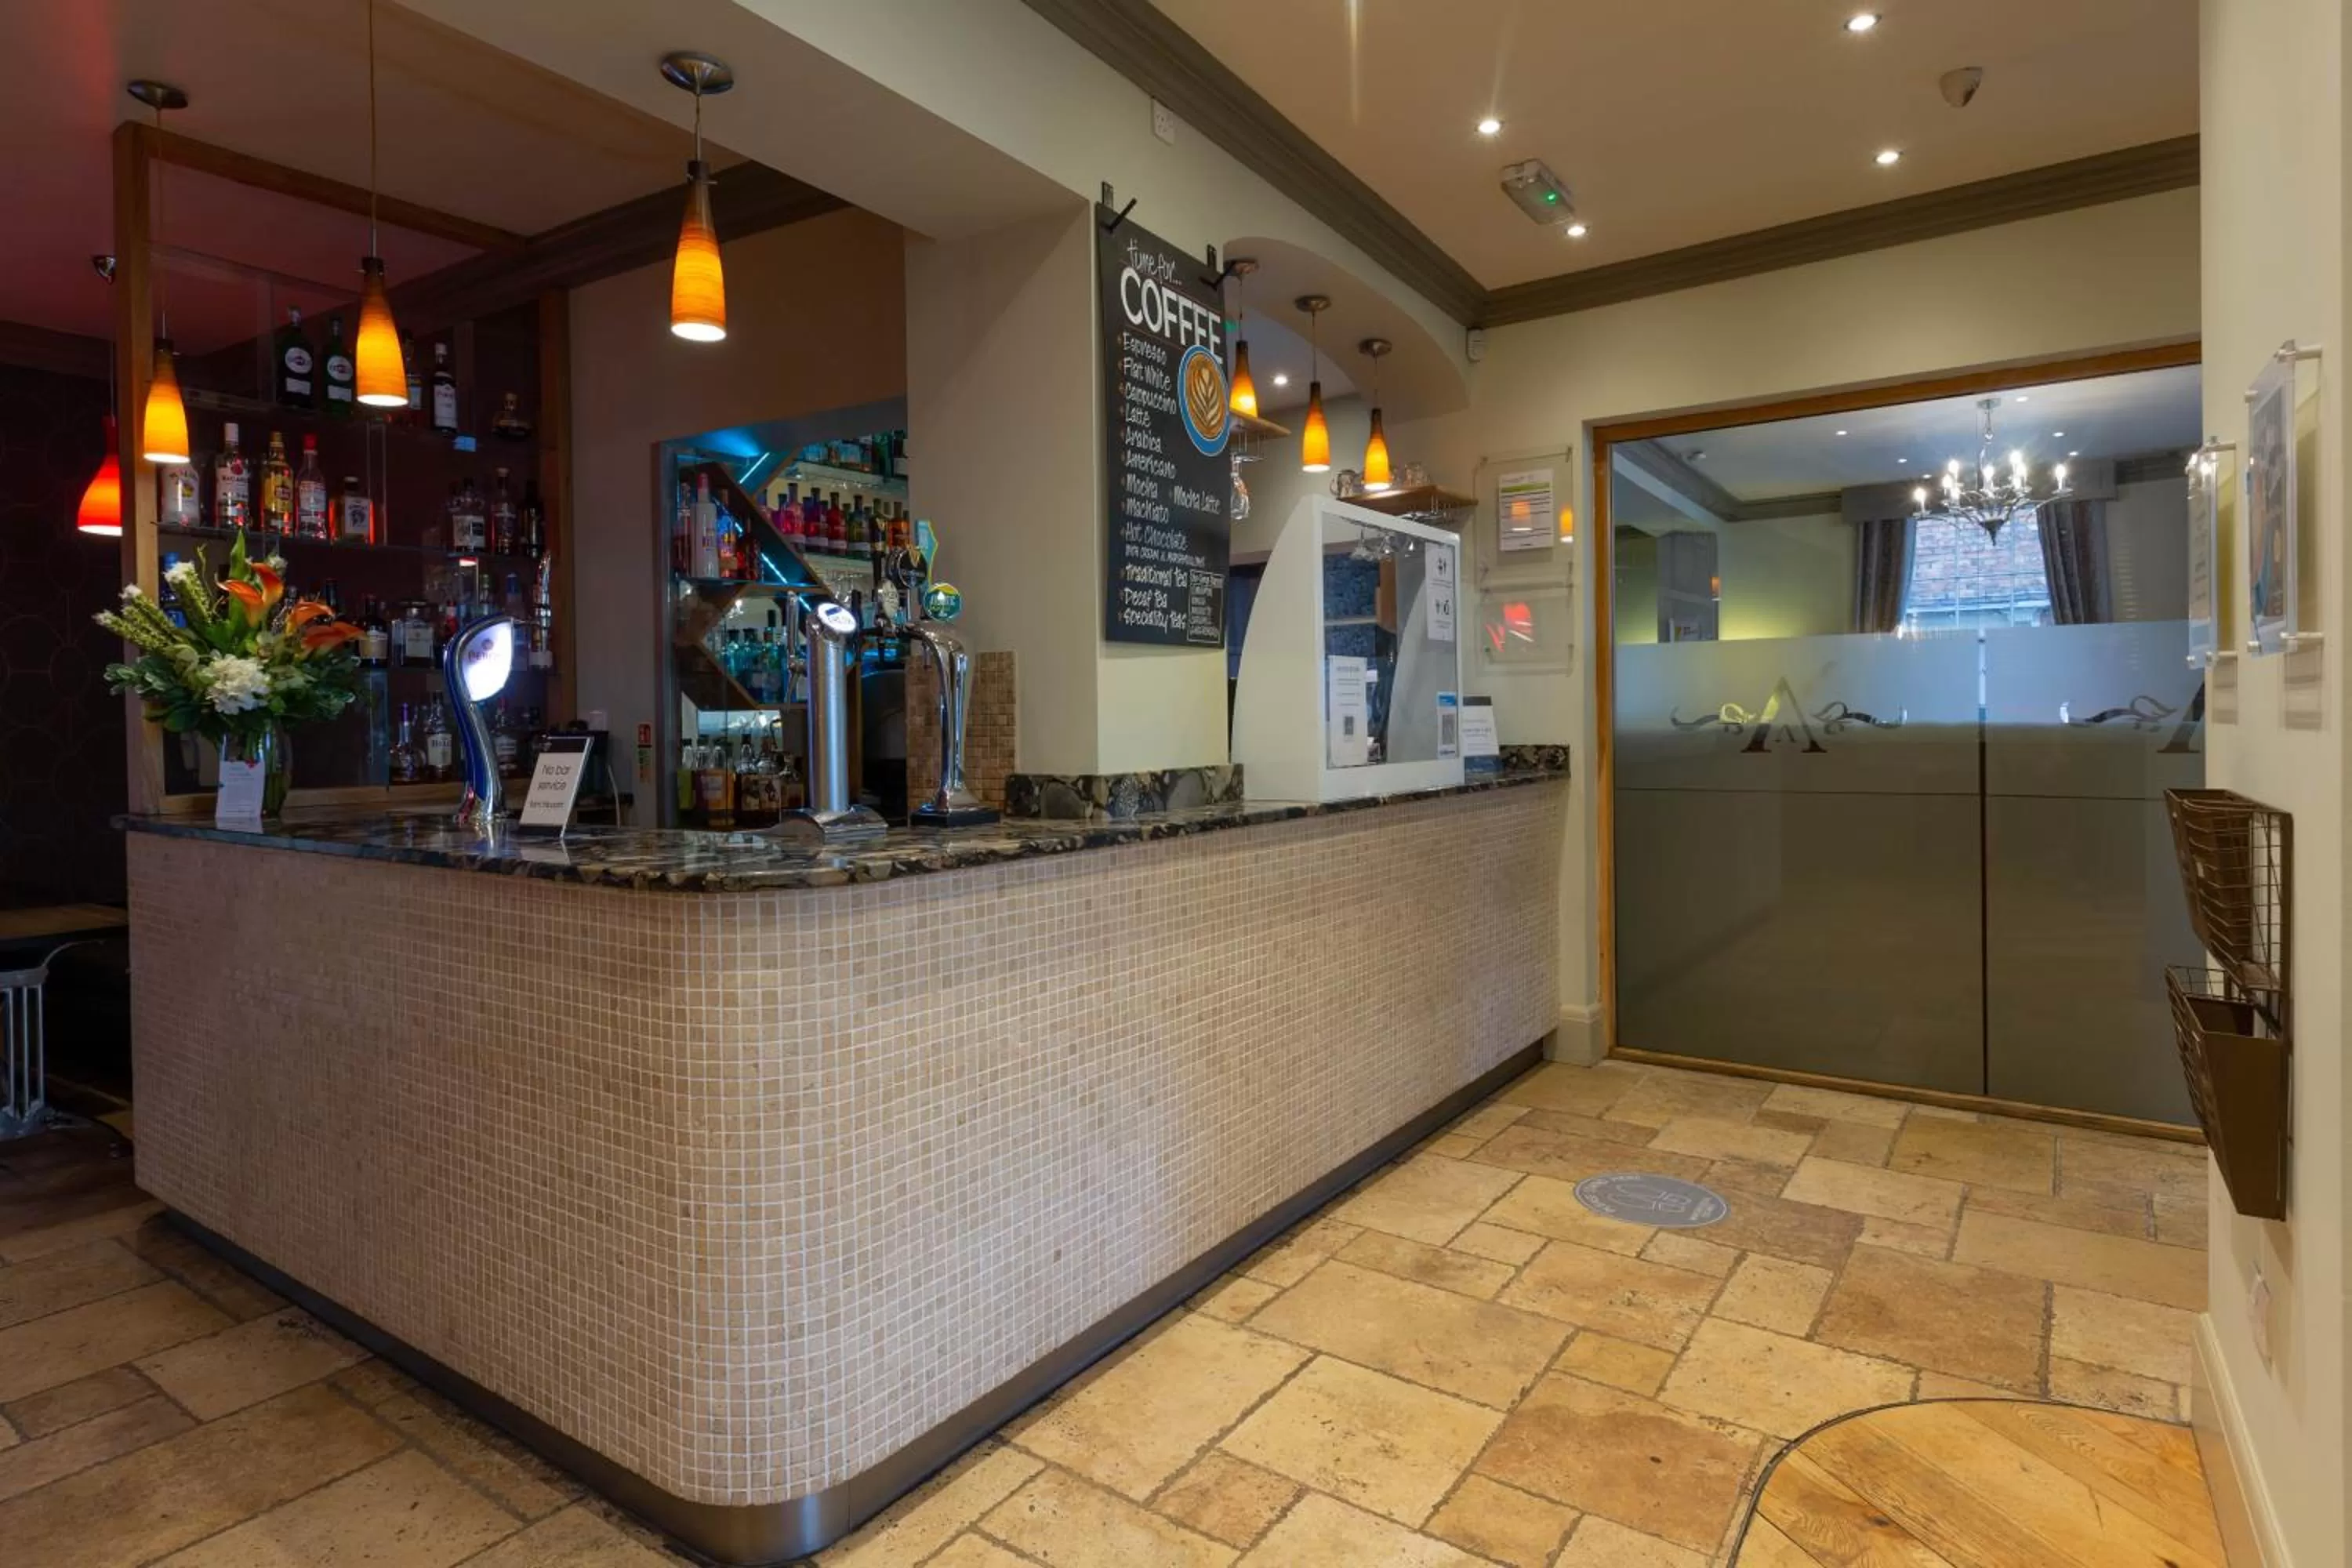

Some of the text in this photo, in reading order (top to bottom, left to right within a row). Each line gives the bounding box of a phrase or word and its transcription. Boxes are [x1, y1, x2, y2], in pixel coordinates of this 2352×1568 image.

[1120, 267, 1223, 364] COFFEE
[1123, 332, 1167, 365] Espresso
[1123, 358, 1172, 391] Flat White
[1125, 382, 1176, 415] Cappuccino
[1125, 402, 1151, 427] Latte
[1125, 426, 1162, 453] Arabica
[1125, 449, 1175, 479] Americano
[1126, 473, 1158, 499] Mocha
[1174, 485, 1200, 510] Mocha
[1125, 521, 1189, 551] Hot Chocolate
[1123, 587, 1152, 612] Decaf
[541, 764, 571, 775] No bar
[537, 781, 567, 791] service
